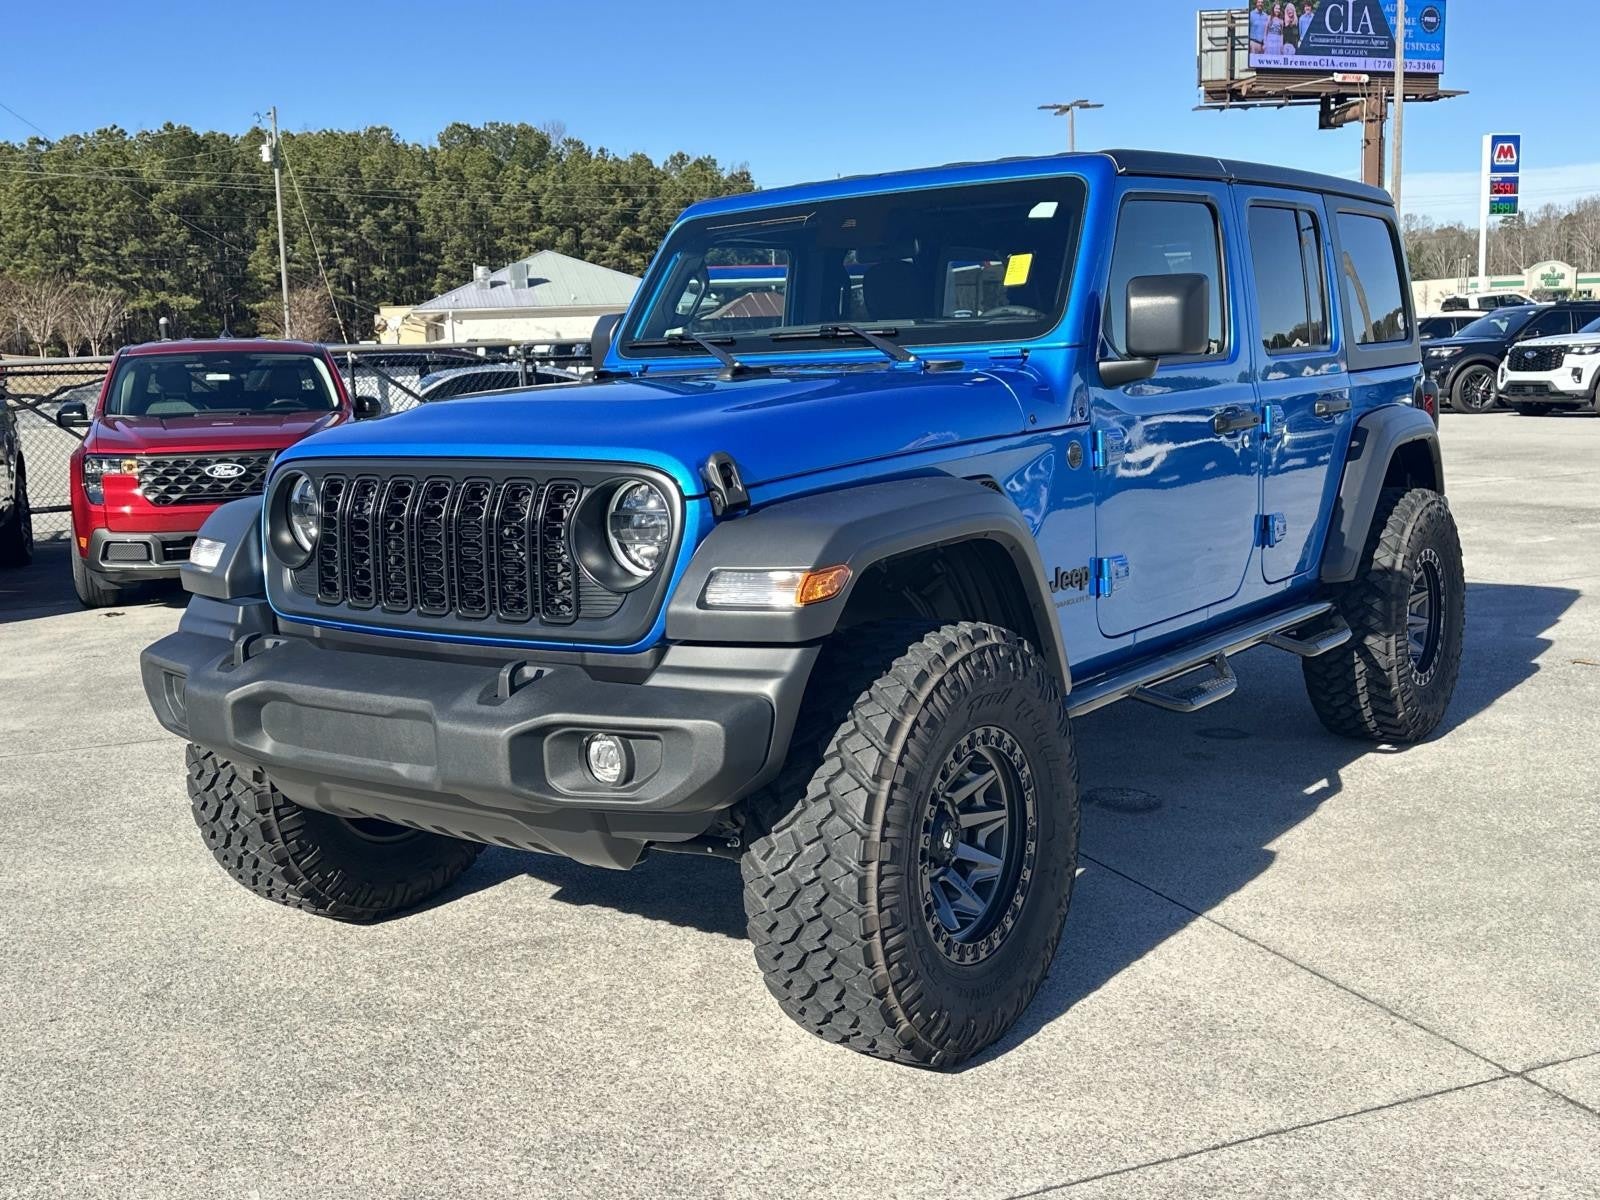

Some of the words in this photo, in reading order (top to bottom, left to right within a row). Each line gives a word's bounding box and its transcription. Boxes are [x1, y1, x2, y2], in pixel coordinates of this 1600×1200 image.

[1384, 3, 1409, 13] AUO
[1325, 0, 1376, 35] CIA
[1389, 15, 1417, 26] HME
[1403, 41, 1441, 52] USINESS
[1257, 57, 1358, 69] www.BremenCIA.com
[1049, 566, 1090, 593] Jeep
